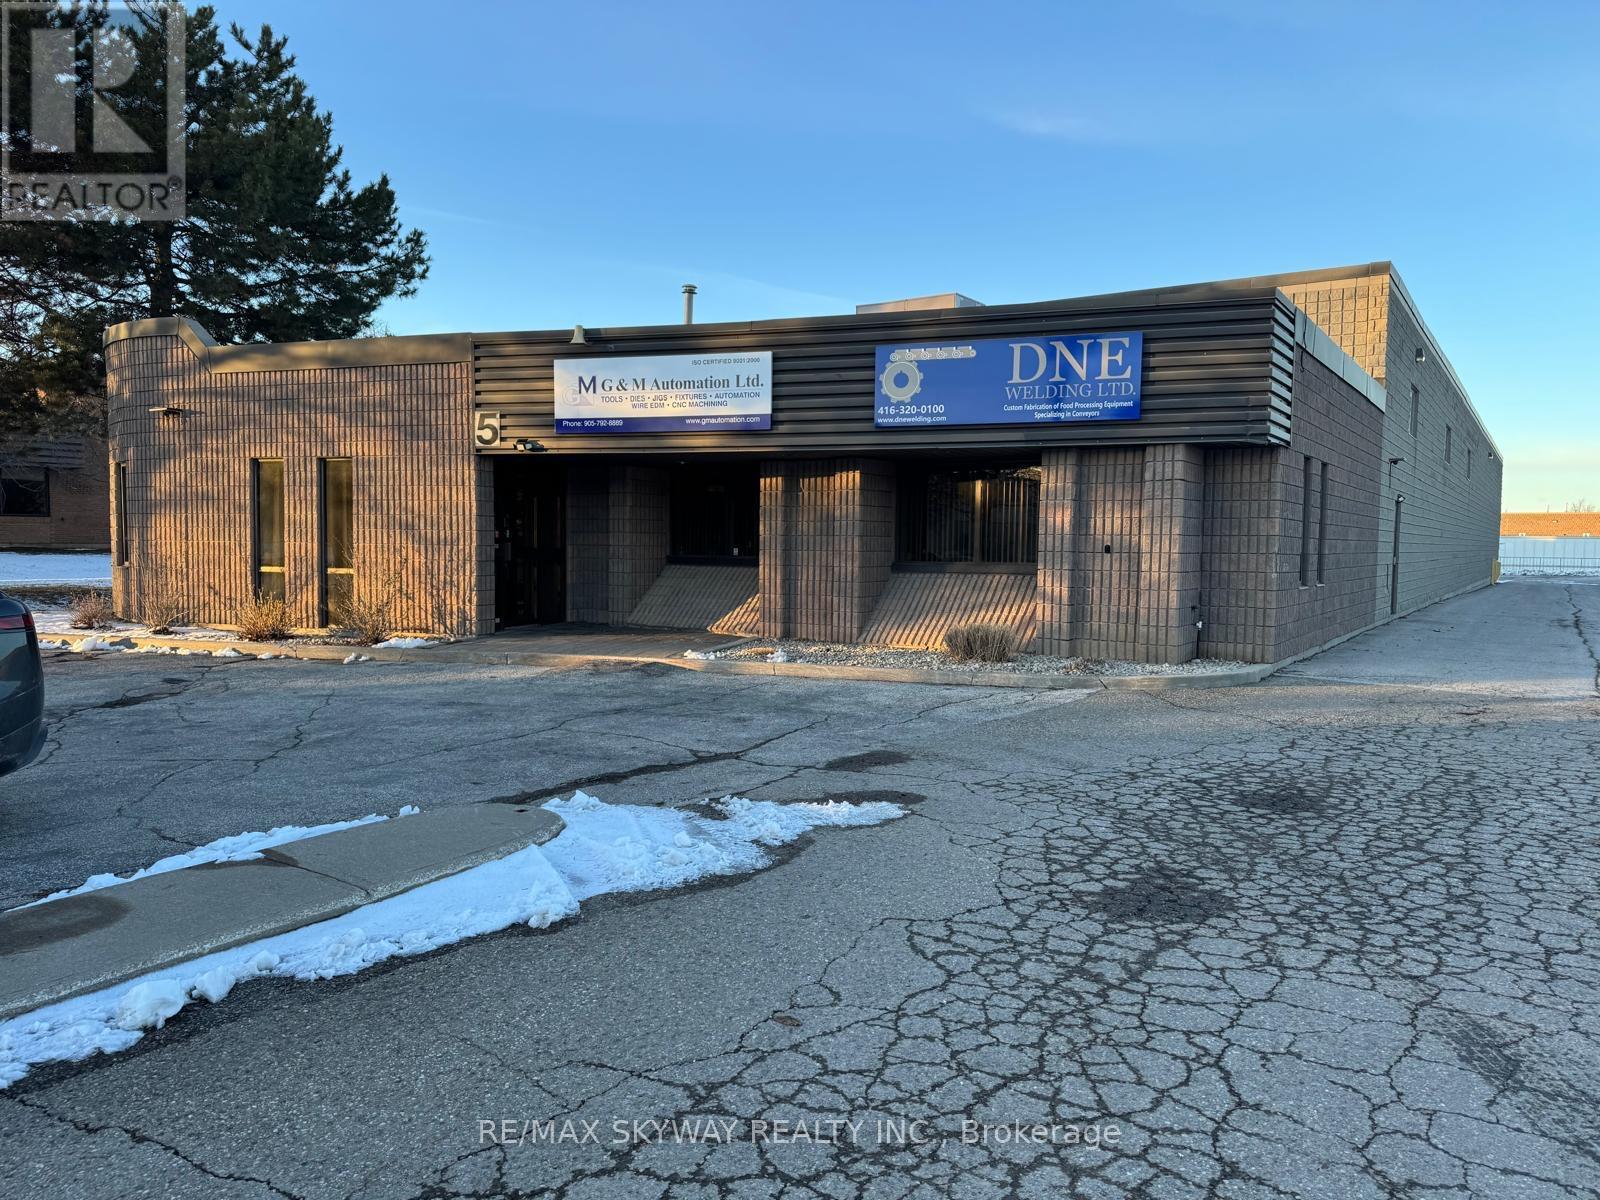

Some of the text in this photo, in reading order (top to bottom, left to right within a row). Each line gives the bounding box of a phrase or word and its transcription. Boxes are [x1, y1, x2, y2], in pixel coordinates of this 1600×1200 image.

[1008, 338, 1132, 384] DNE
[601, 379, 613, 391] G
[632, 378, 646, 391] M
[650, 376, 730, 390] Automation
[736, 374, 764, 388] Ltd.
[1004, 381, 1136, 400] WELDING LTD.
[601, 395, 623, 403] TOOLS
[877, 404, 944, 415] 416-320-0100
[1024, 403, 1052, 411] Fabrication
[1074, 401, 1103, 410] Processing
[1104, 400, 1133, 409] Equipment
[877, 415, 946, 424] www.dnewelding.com
[1034, 411, 1065, 419] Specializing
[1072, 410, 1100, 418] Conveyors
[685, 416, 760, 425] www.gmautomation.com
[476, 413, 498, 445] 5
